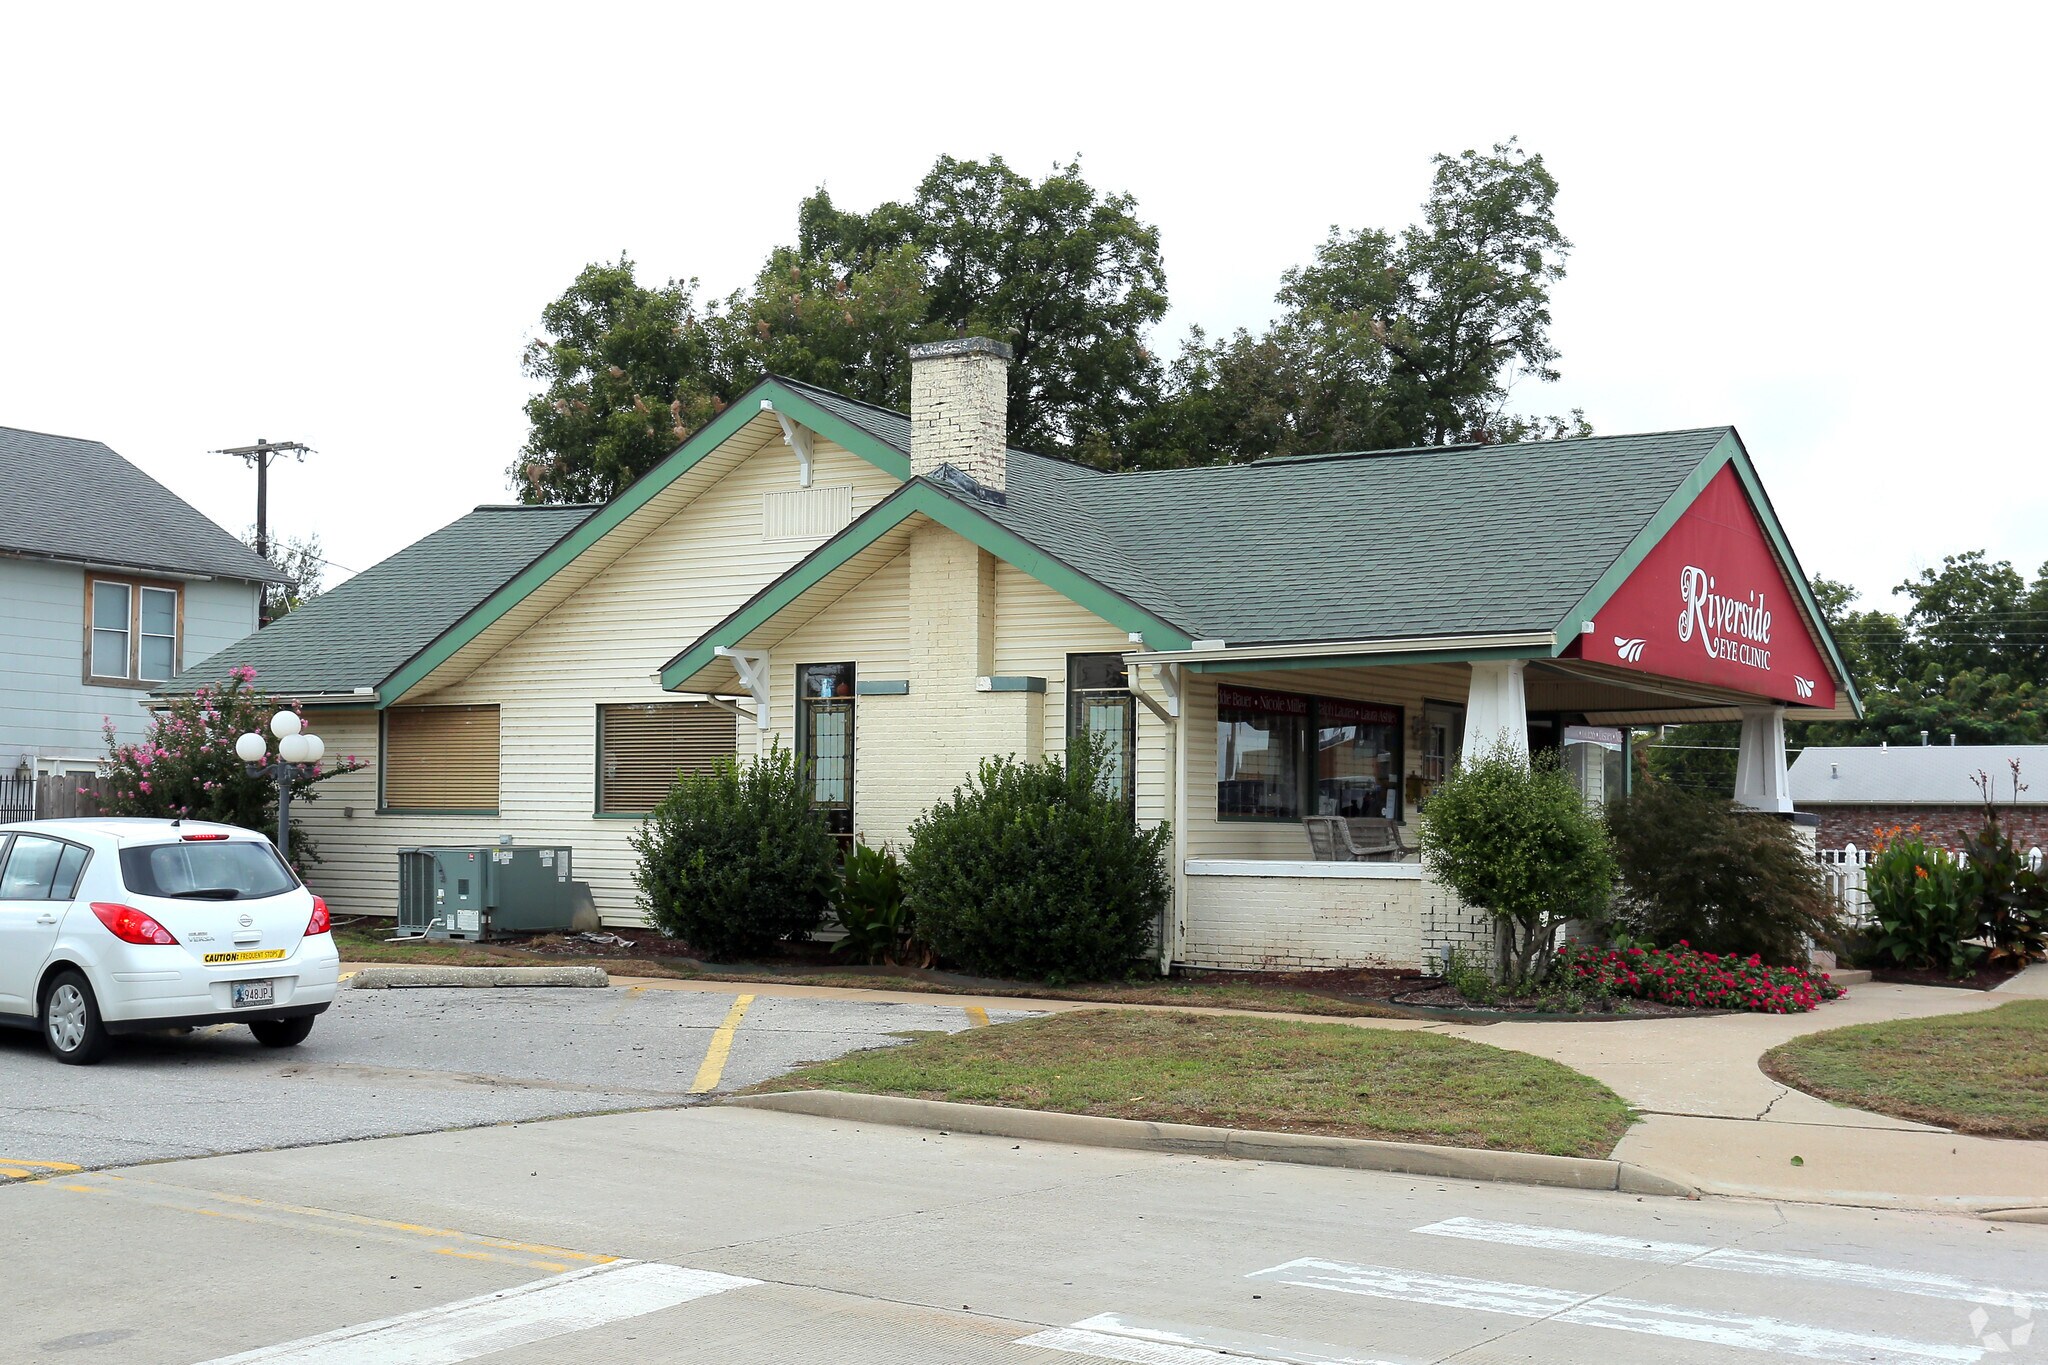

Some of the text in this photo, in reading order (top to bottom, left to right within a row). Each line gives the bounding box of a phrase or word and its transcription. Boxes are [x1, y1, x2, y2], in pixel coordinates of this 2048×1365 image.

[1678, 565, 1771, 658] Riverside
[1719, 638, 1771, 670] EYE CLINIC
[1232, 691, 1252, 707] Bauer
[1260, 695, 1285, 711] Nicole
[1286, 698, 1308, 713] Miller
[1335, 703, 1356, 720] Lauren
[1360, 706, 1378, 721] Laura
[204, 950, 278, 962] CAUTION: FREQUENT STOPS
